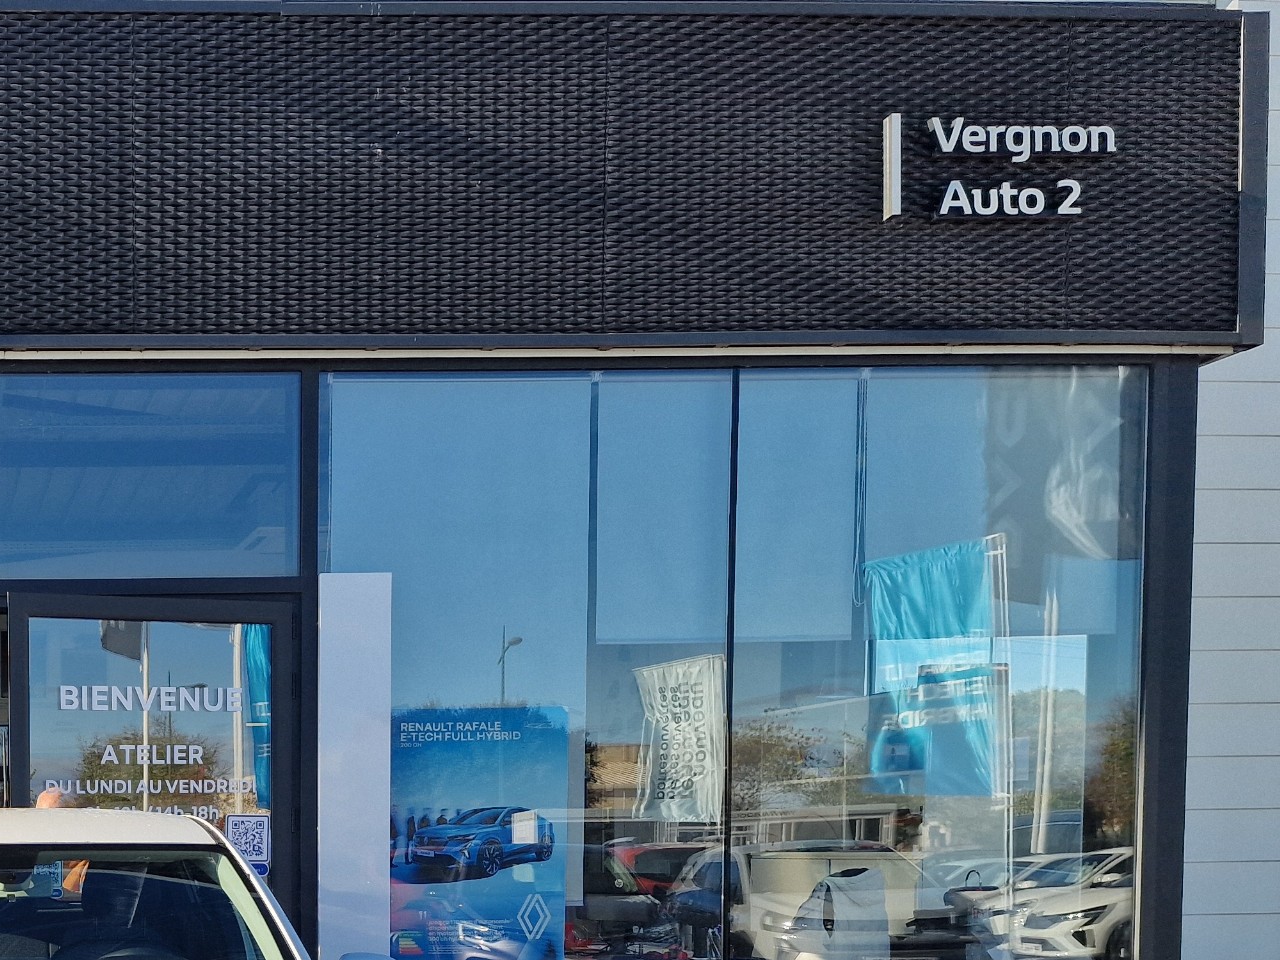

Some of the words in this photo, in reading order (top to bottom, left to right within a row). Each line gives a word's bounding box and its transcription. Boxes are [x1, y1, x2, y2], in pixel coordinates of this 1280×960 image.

[928, 117, 1117, 162] Vergnon
[939, 180, 1045, 215] Auto
[1057, 179, 1082, 214] 2
[59, 685, 243, 712] BIENVENUE
[400, 722, 454, 732] RENAULT
[456, 722, 502, 731] RAFALE
[400, 732, 442, 742] E-TECH
[444, 732, 475, 741] FULL
[477, 731, 522, 741] HYBRID
[100, 745, 204, 765] ATELIER
[45, 780, 71, 794] DU
[76, 780, 132, 794] LUNDI
[136, 780, 162, 794] AU
[165, 779, 258, 794] VENDREDI
